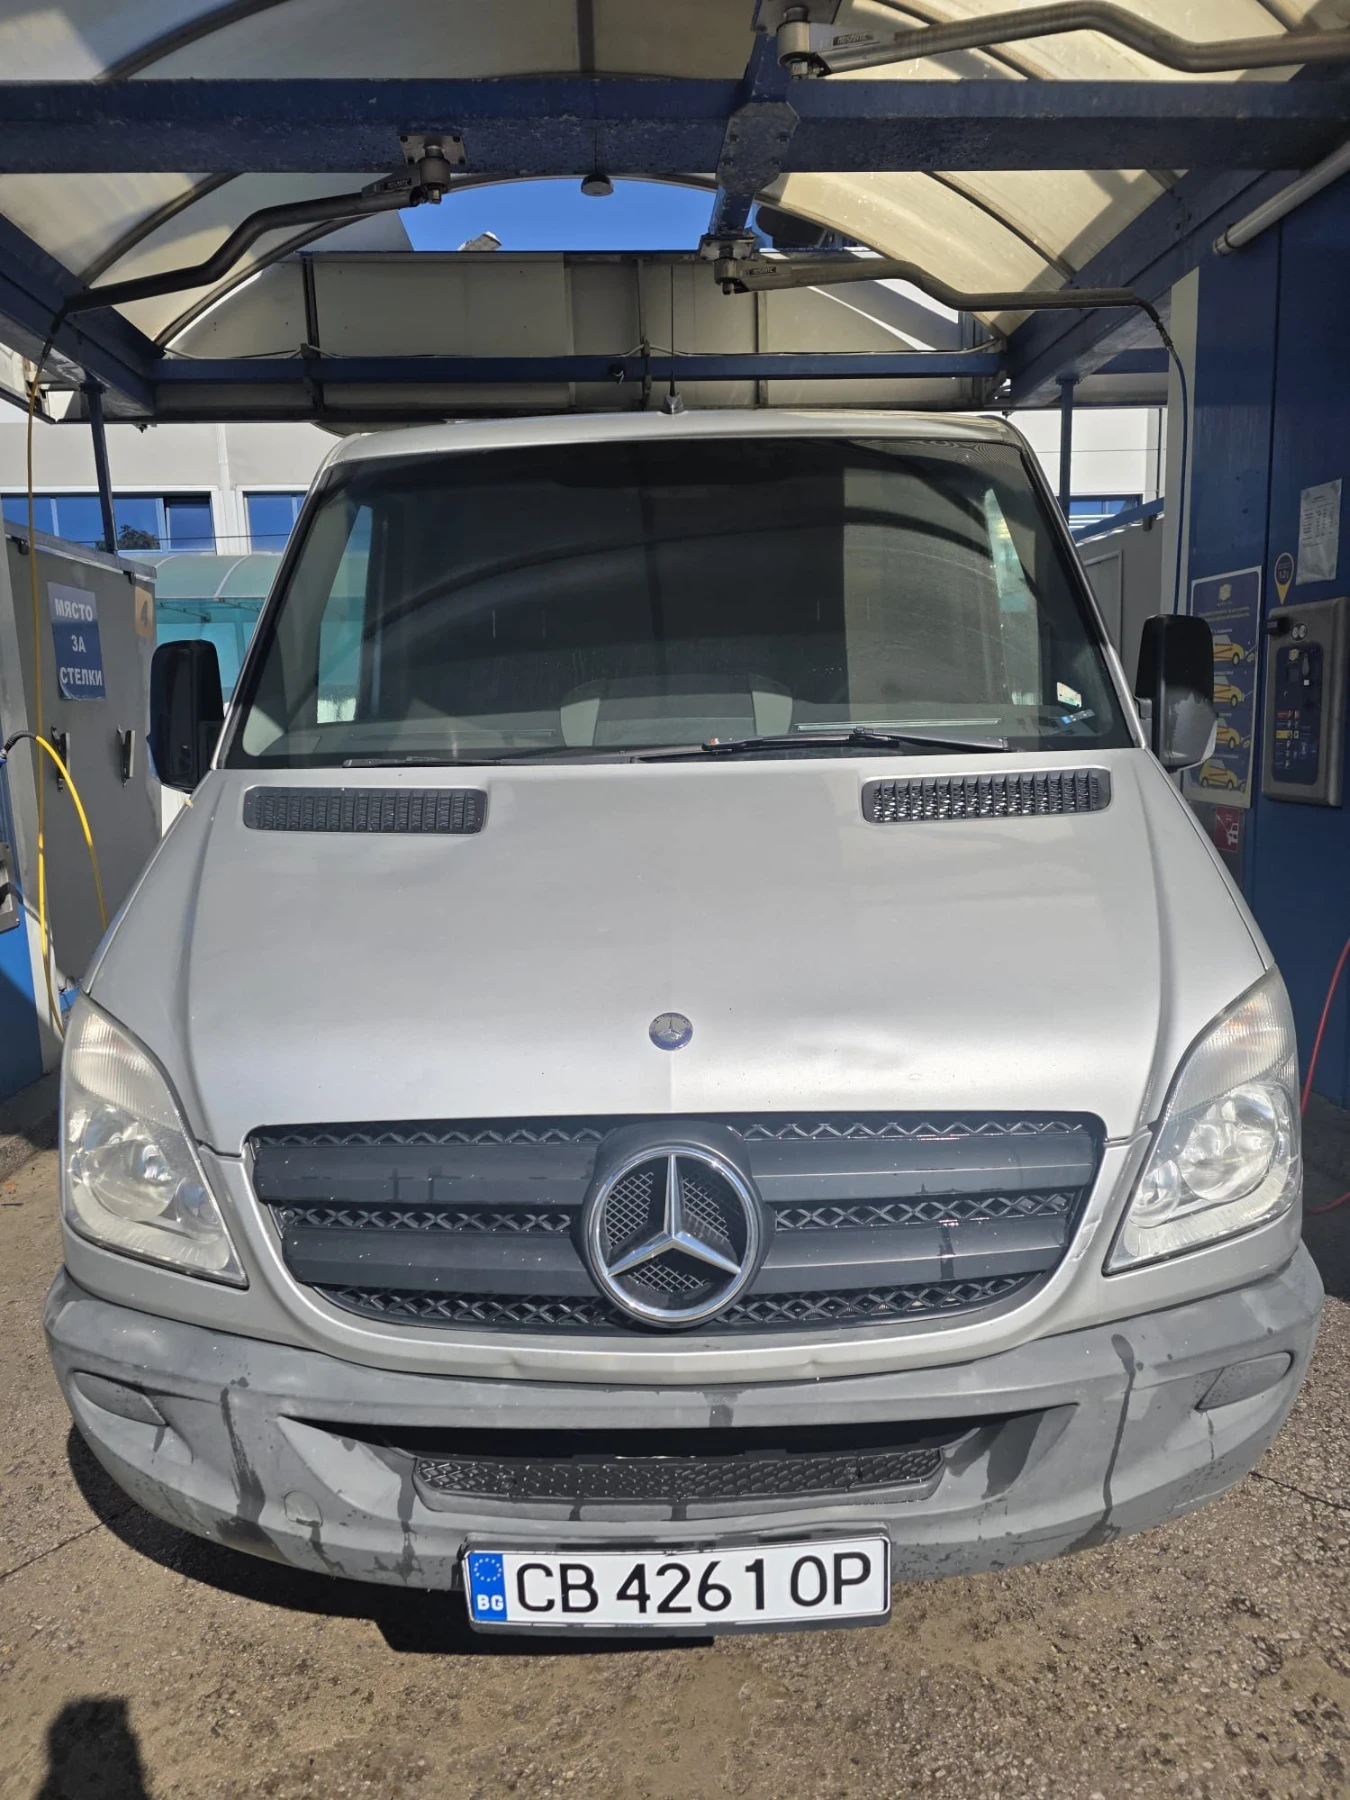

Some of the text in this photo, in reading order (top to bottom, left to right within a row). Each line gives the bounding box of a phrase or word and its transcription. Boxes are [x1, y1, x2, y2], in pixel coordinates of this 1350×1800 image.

[54, 598, 93, 622] МЯСТО
[141, 600, 149, 627] 4
[71, 634, 87, 653] ЗА
[59, 666, 103, 686] СТЕЛКИ
[516, 1551, 872, 1614] CB 4261 OP
[477, 1593, 504, 1611] BG
